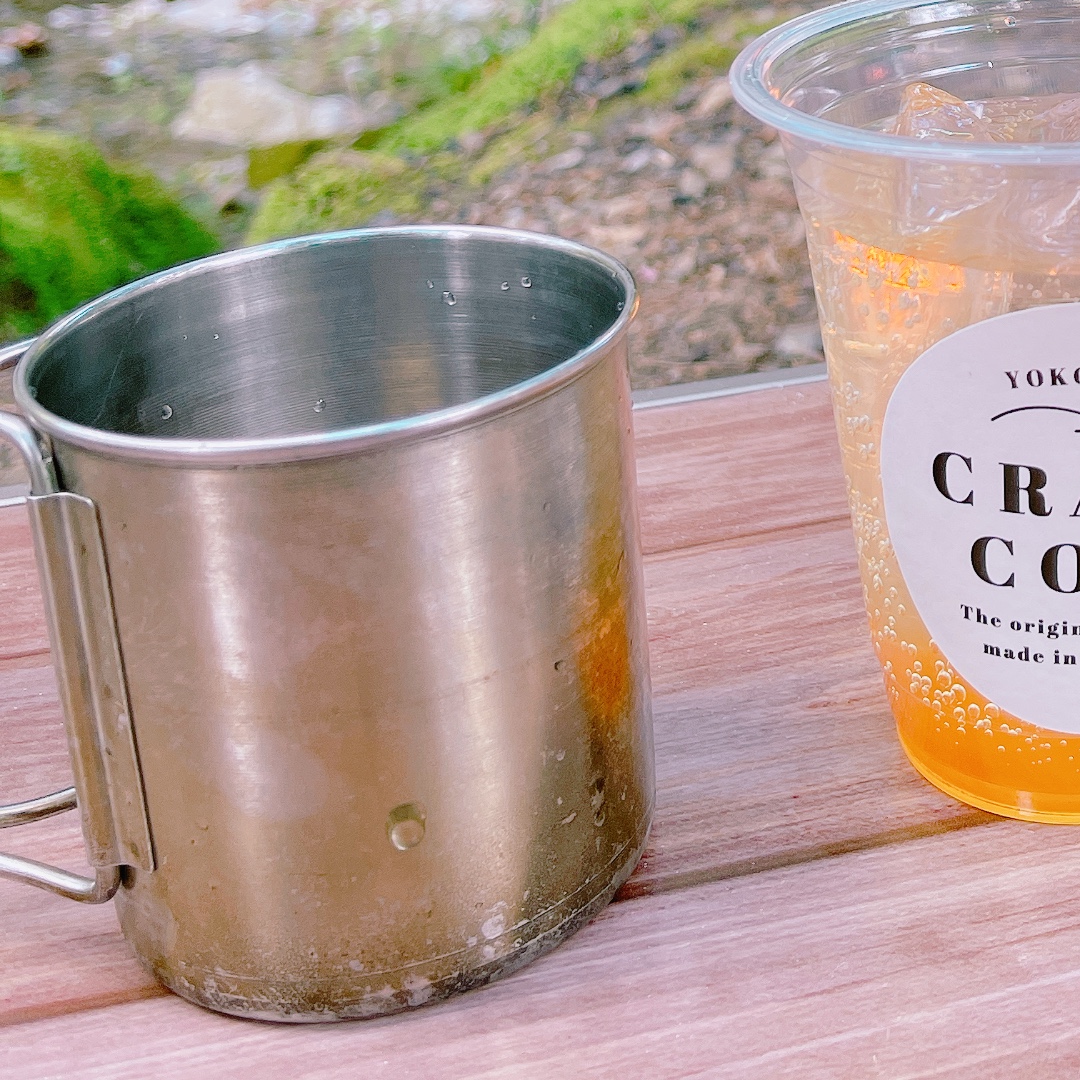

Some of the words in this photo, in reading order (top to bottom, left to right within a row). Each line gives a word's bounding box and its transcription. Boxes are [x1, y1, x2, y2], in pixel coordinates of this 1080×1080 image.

[960, 603, 1002, 627] The
[983, 642, 1044, 664] made
[1054, 650, 1077, 665] in
